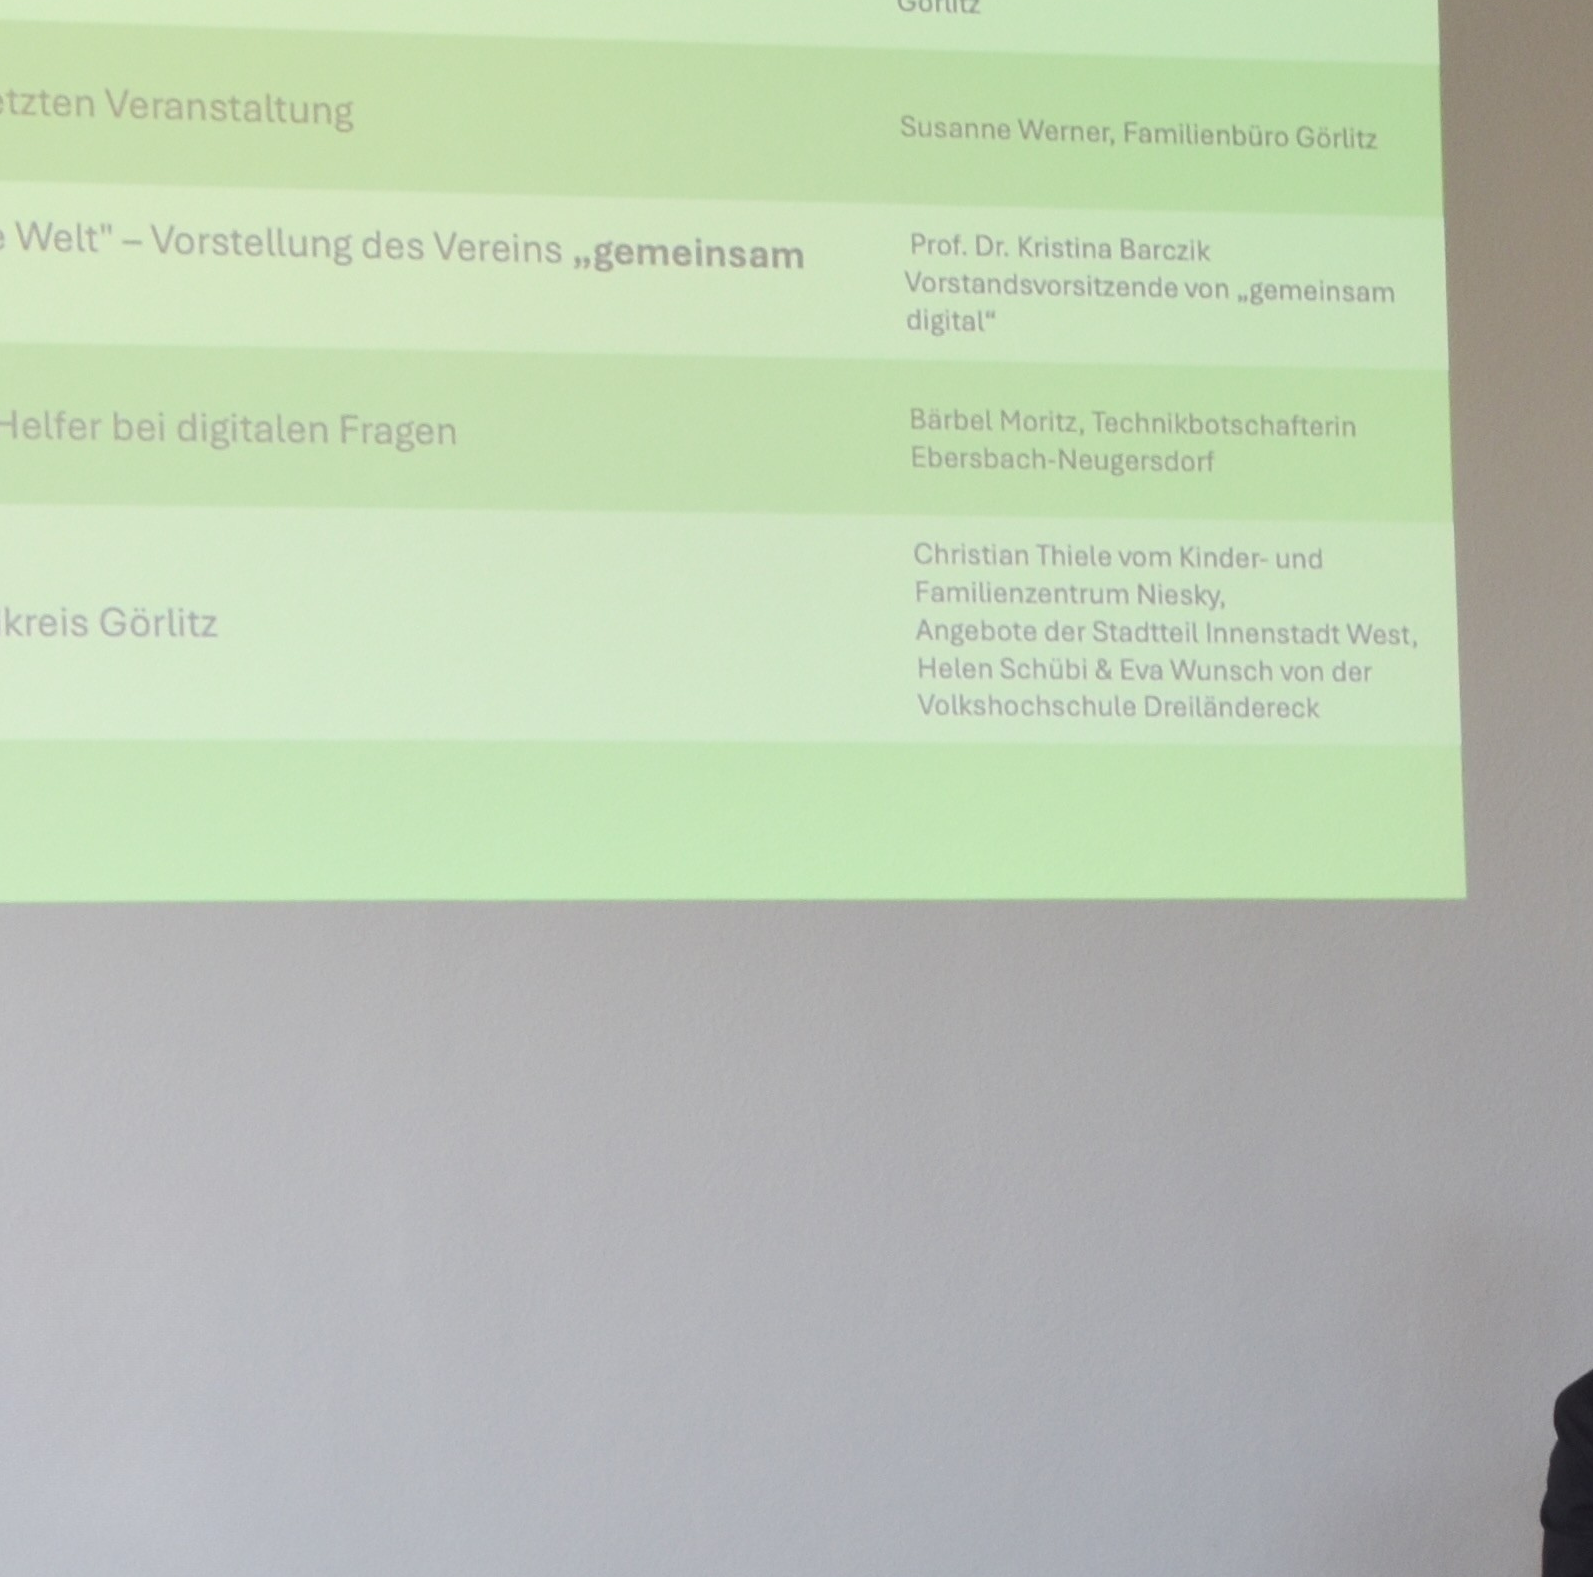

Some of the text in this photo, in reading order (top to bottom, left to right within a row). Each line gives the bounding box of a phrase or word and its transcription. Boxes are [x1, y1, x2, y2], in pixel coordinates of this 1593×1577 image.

[105, 88, 354, 133] Veranstaltung
[901, 115, 1377, 149] Susanne Werner, Familienbüro Görlitz
[151, 224, 353, 266] Vorstellung
[362, 230, 424, 260] des
[433, 231, 562, 263] Vereins
[911, 233, 1210, 261] Prof. Dr. Kristina Barczik
[905, 271, 1178, 298] Vorstandsvorsitzende
[1184, 282, 1229, 298] von
[113, 412, 164, 441] bei
[177, 413, 328, 450] digitalen
[341, 414, 456, 452] Fragen
[911, 408, 1356, 437] Bärbel Moritz, Technikbotschafterin
[912, 445, 1214, 476] Ebersbach-Neugersdorf
[914, 542, 1323, 569] Christian Thiele vom Kinder- und
[916, 580, 1225, 611] Familienzentrum Niesky,
[100, 607, 217, 637] Görlitz
[916, 619, 1417, 648] Angebote der Stadtteil Innenstadt West,
[918, 657, 1372, 682] Helen Schübi & Eva Wunsch von der
[918, 694, 1319, 718] Volkshochschule Dreiländereck
